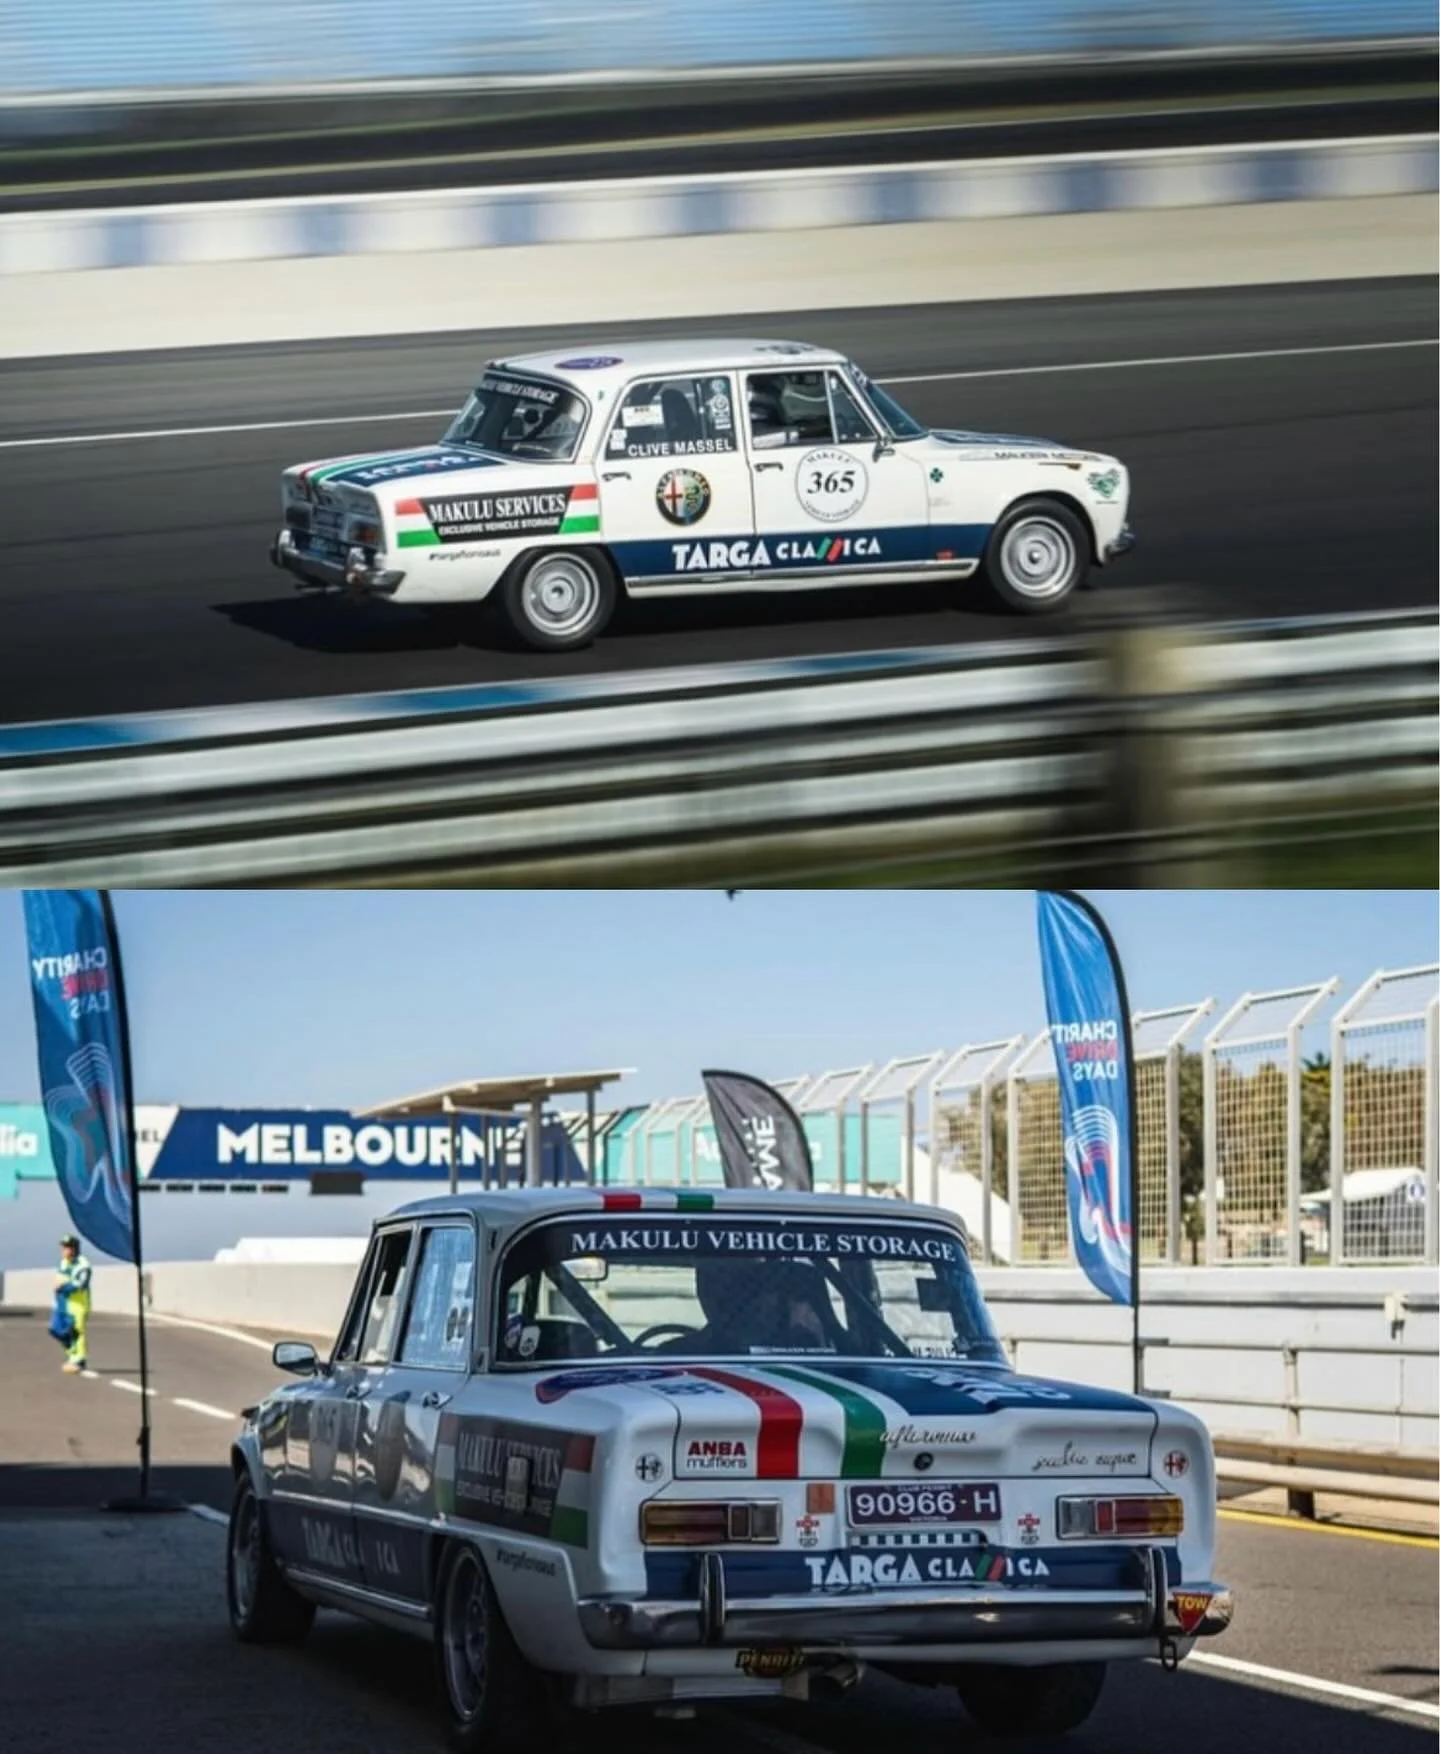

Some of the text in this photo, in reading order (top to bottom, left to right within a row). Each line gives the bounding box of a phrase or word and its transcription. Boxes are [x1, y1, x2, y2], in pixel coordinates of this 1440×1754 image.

[628, 438, 733, 457] CLIVE MASSEL
[806, 470, 856, 494] 365
[429, 493, 566, 523] MAKULU SERVICES
[672, 540, 771, 570] TARGA
[134, 1128, 160, 1143] EL
[217, 1123, 522, 1166] MELBOURNE
[571, 1230, 957, 1263] MAKULU VEHICLE STORAGE
[688, 1441, 746, 1456] ANBA
[686, 1456, 748, 1469] mufflers
[804, 1553, 923, 1585] TARGA
[1176, 1596, 1208, 1610] TOW
